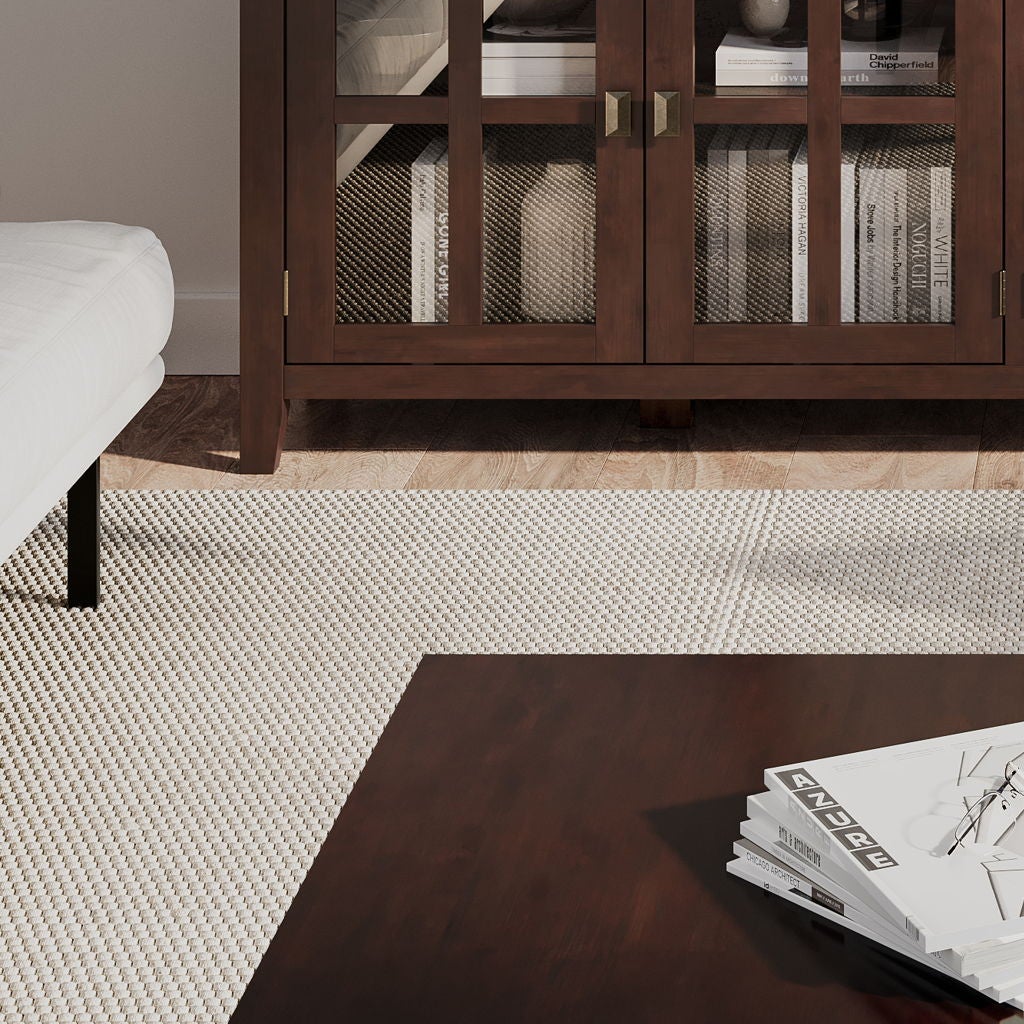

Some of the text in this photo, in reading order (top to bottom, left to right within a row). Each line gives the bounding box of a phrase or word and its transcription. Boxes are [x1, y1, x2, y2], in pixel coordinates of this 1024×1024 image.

[869, 53, 899, 61] David
[869, 61, 934, 70] Chipperfield
[770, 73, 808, 82] down
[798, 175, 807, 220] VICTORIA
[798, 222, 807, 256] HAGAN
[866, 225, 876, 243] Jobs
[892, 225, 902, 237] The
[892, 237, 902, 262] Interior
[911, 222, 927, 288] NOGUCHI
[933, 235, 948, 287] WHITE
[891, 262, 902, 285] Design
[790, 772, 895, 870] AZURE
[746, 852, 770, 872] CHICAGO
[771, 867, 801, 889] ARCHITECT
